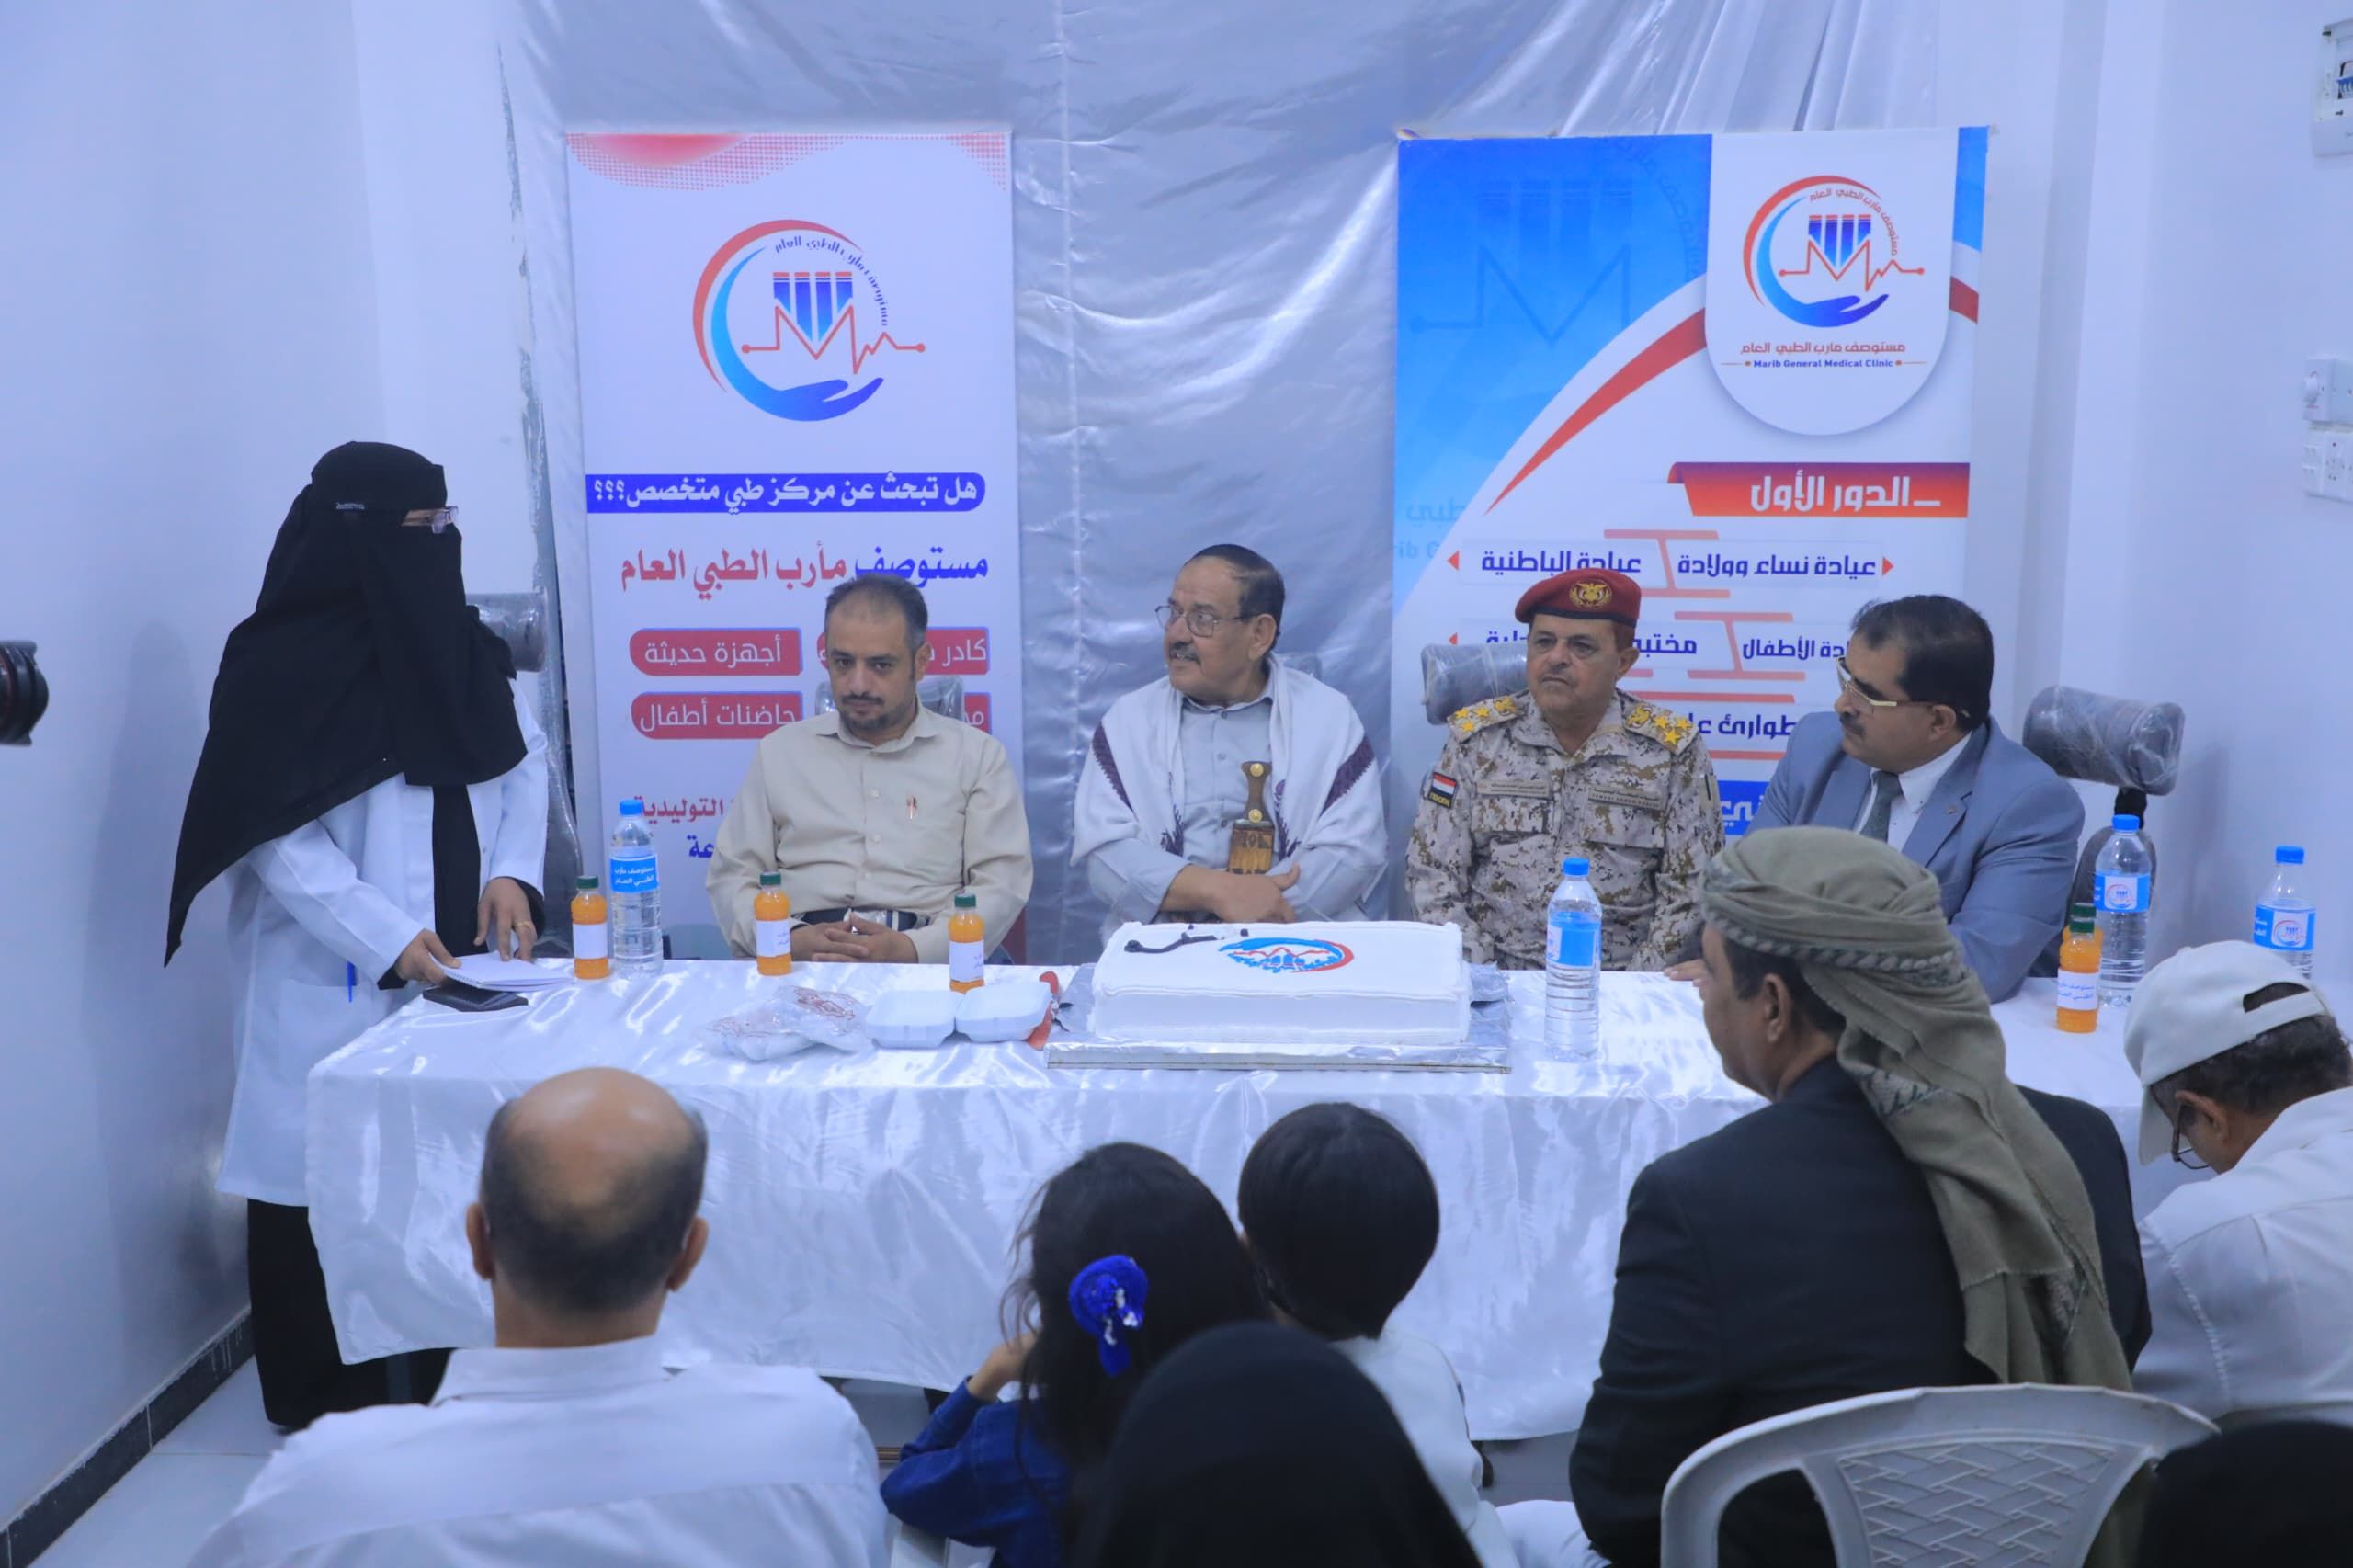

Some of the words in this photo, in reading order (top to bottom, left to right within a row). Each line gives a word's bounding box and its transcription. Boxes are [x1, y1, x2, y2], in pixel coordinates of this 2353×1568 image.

[1740, 342, 1771, 355] العام
[1775, 342, 1812, 356] الطبي
[1845, 340, 1906, 355] مستوصف
[1753, 359, 1781, 369] Marib
[1783, 359, 1822, 369] General
[1824, 358, 1862, 368] Medical
[1865, 358, 1893, 368] Clinic
[723, 477, 765, 516] طبي
[767, 475, 836, 507] مركز
[840, 479, 876, 507] عن
[880, 471, 939, 507] تبحث
[943, 476, 977, 506] هل
[1750, 469, 1825, 512] الأول
[621, 549, 686, 593] العام
[693, 549, 768, 600] الطبي
[775, 540, 847, 590] مأرب
[855, 546, 988, 588] مستوصف
[1482, 551, 1571, 576] الباطنية
[1677, 553, 1749, 578] وولادة
[1754, 555, 1809, 578] نساء
[1813, 554, 1877, 580] عيادة
[644, 641, 707, 666] حديثة
[714, 634, 782, 668] أجهزة
[941, 638, 987, 667] كادر
[1743, 635, 1815, 661] الأطفال
[640, 698, 707, 733] أطفال
[716, 704, 796, 726] حاضنات
[634, 796, 724, 824] التوليدي
